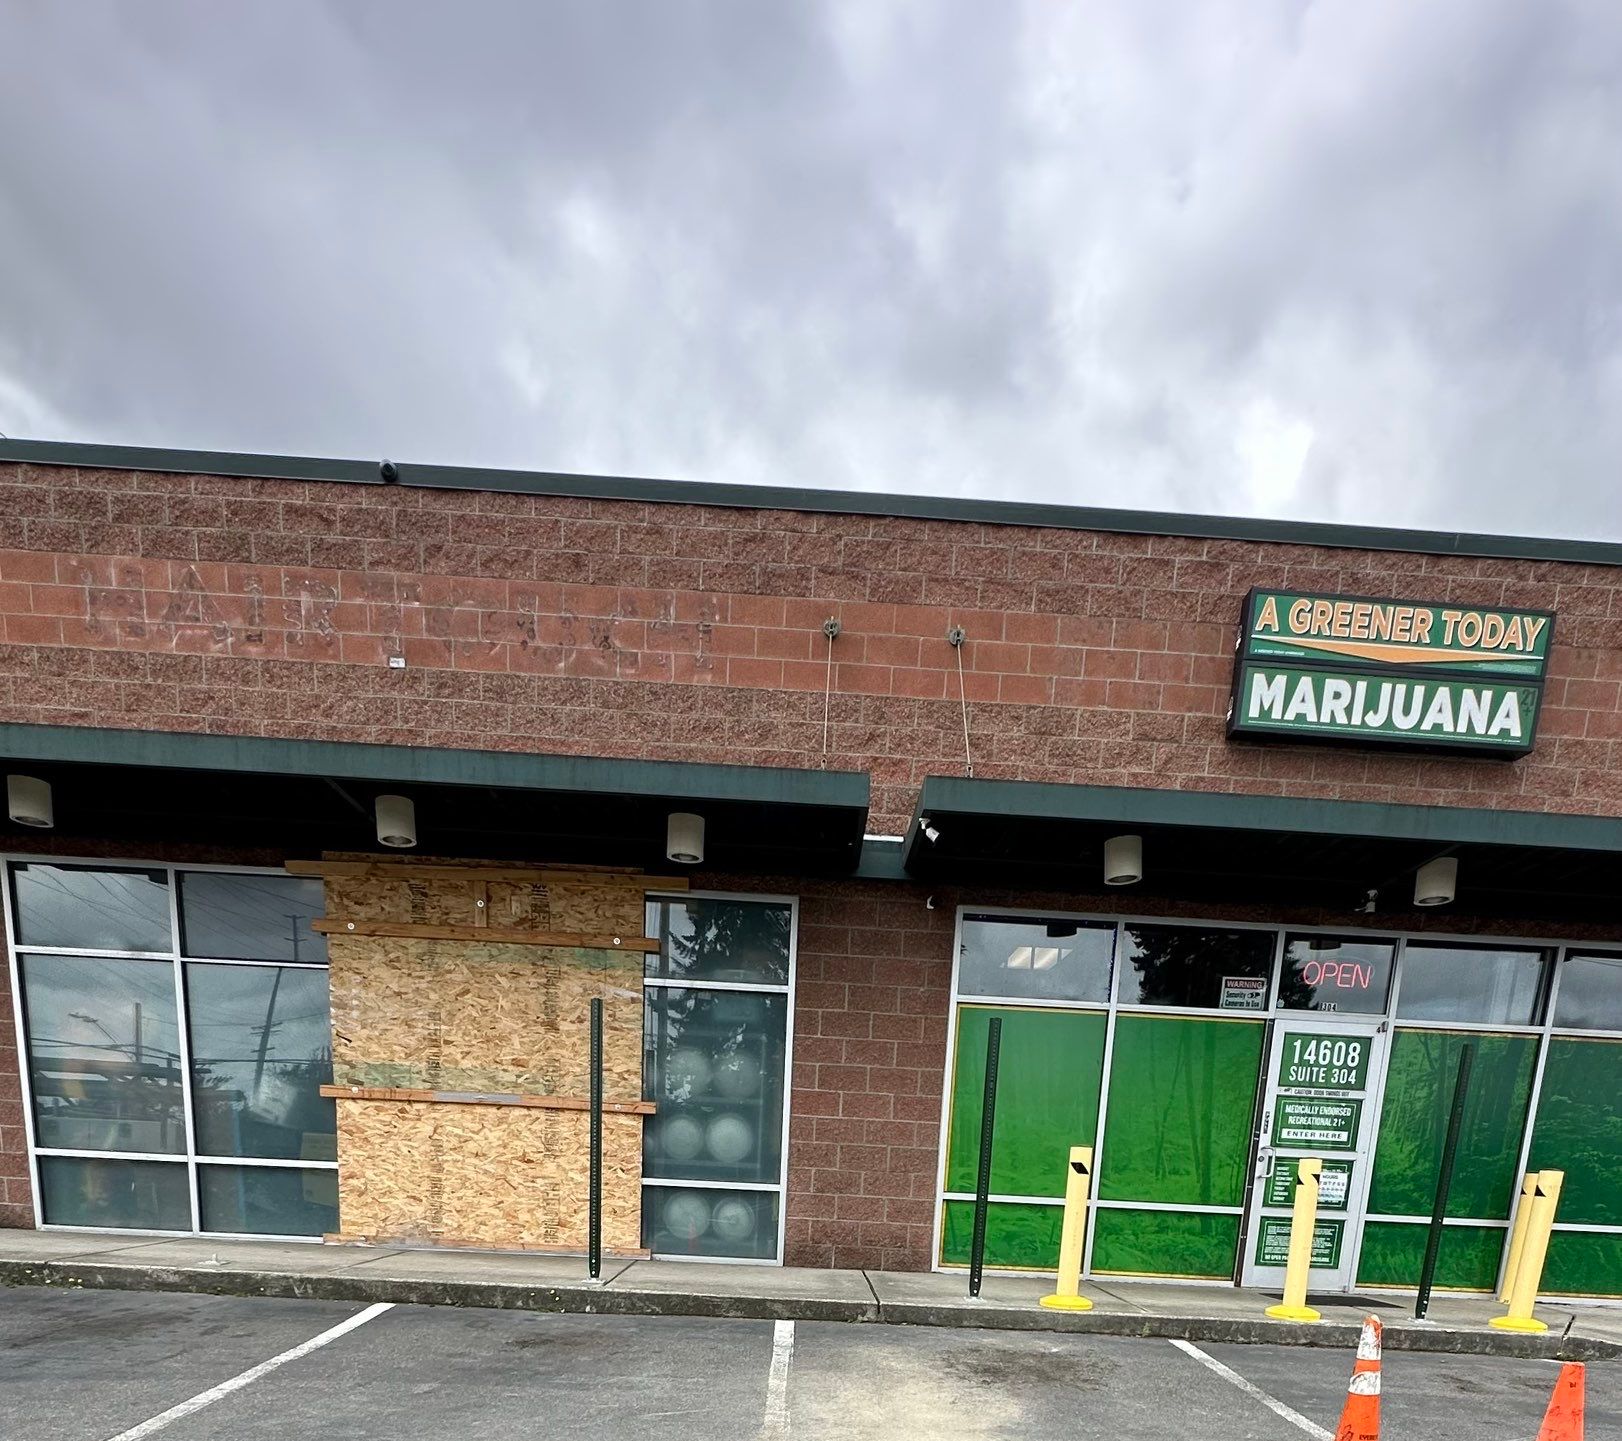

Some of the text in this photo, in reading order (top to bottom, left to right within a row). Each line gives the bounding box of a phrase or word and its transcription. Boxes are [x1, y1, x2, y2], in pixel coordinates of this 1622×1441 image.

[1255, 597, 1546, 652] A GREENER TODAY
[1248, 673, 1522, 737] MARIJUANA
[1226, 980, 1263, 989] WARNING
[1303, 961, 1371, 989] OPEN
[1293, 1039, 1361, 1067] 14608
[1289, 1065, 1357, 1084] SUITE 304
[1285, 1104, 1351, 1116] MEDICALLY ENDORSED
[1288, 1115, 1345, 1127] RECREATIONAL 21+
[1286, 1130, 1316, 1138] ENTER
